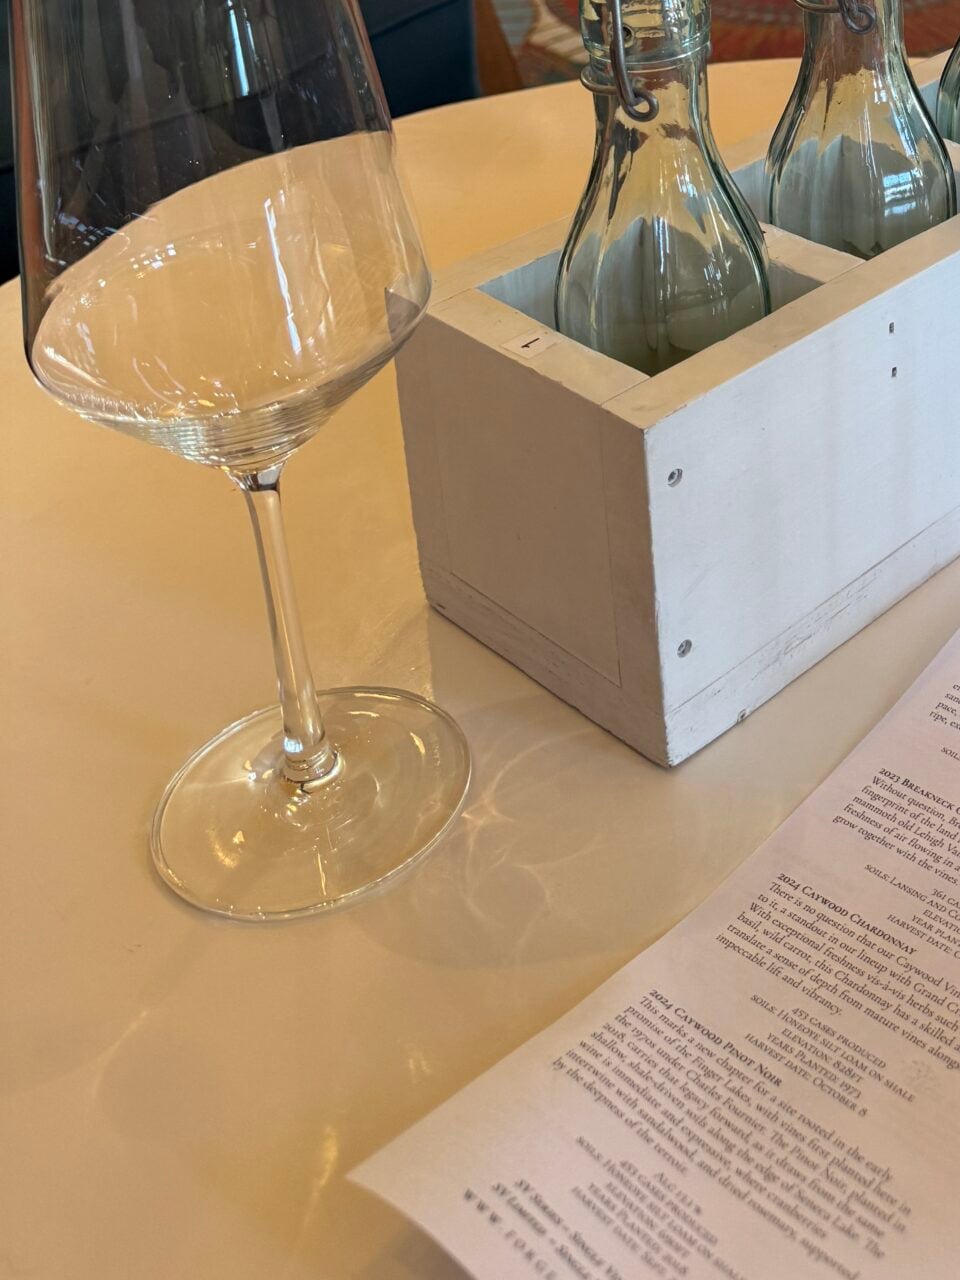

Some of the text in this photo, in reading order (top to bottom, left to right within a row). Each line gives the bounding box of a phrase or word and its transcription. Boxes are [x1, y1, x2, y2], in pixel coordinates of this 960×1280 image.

[860, 784, 910, 815] fingerprint
[906, 810, 925, 821] of
[917, 813, 936, 829] the
[934, 822, 960, 841] land
[871, 774, 908, 800] Without
[877, 767, 901, 783] 2023
[899, 778, 955, 811] BREAKNECK
[851, 795, 898, 823] mammoth
[896, 819, 916, 832] old
[911, 825, 945, 848] Lehigh
[768, 881, 794, 902] There
[792, 896, 804, 907] is
[801, 903, 817, 915] no
[814, 911, 856, 938] question
[855, 933, 878, 950] that
[874, 946, 896, 960] our
[894, 954, 944, 987] Caywood
[775, 872, 917, 955] 2024 CAYWOOD CHARDONNAY
[885, 913, 928, 939] HARVEST
[714, 931, 767, 968] impeccable
[764, 961, 784, 977] lift
[780, 974, 804, 989] and
[748, 901, 772, 921] With
[770, 918, 827, 952] exceptional
[821, 945, 866, 977] freshness
[865, 972, 906, 1001] vis-à-vis
[904, 993, 935, 1018] herbs
[933, 1013, 960, 1033] such
[648, 989, 782, 1088] 2024 CAYWOOD PINOT NOIR
